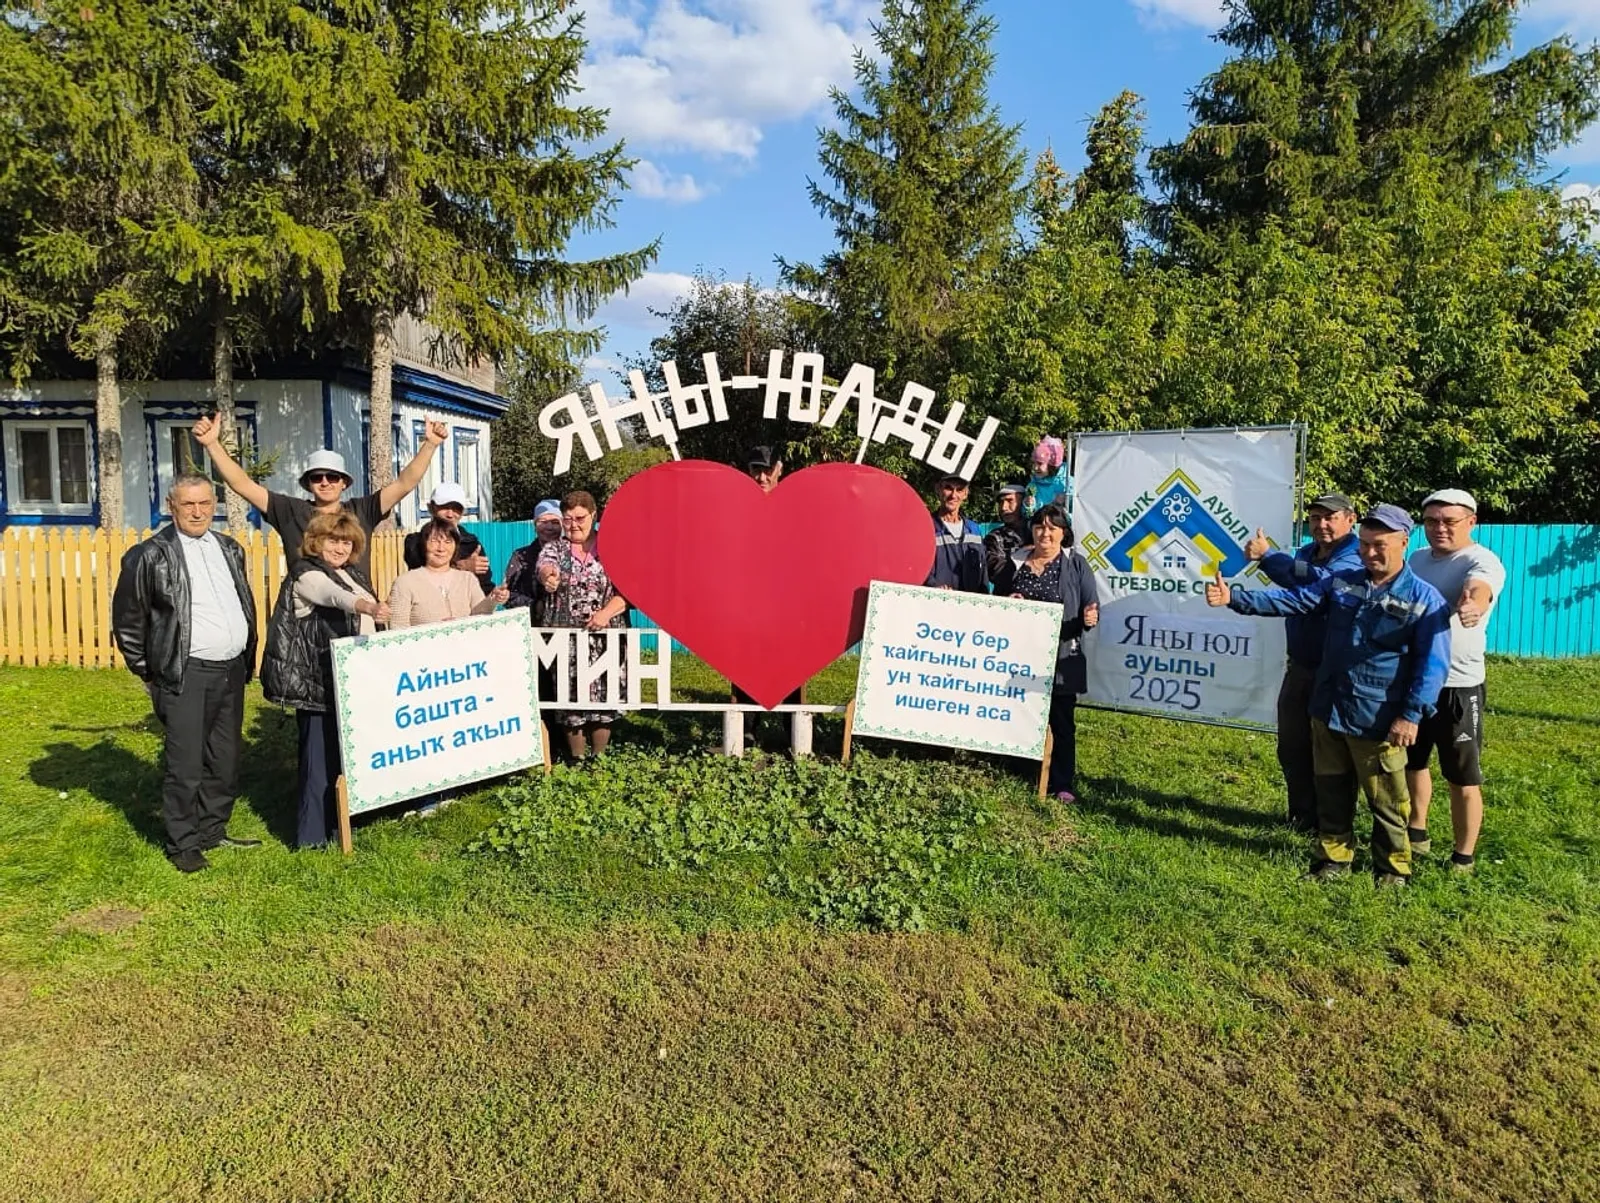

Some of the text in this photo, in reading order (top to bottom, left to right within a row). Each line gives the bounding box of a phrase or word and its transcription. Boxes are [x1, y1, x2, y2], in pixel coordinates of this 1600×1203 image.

[1109, 490, 1249, 541] АЙЫҠ АУЫЛ
[1107, 575, 1245, 596] ТРЕЗВОЕ СО
[916, 621, 1010, 652] Эсеү бер
[1117, 614, 1252, 657] Яңы юл
[531, 628, 671, 707] МИН
[882, 643, 977, 669] ҡайғыны
[1124, 653, 1215, 678] ауылы
[395, 660, 488, 697] Айныҡ
[886, 669, 911, 686] ун
[1129, 675, 1201, 711] 2025
[394, 695, 478, 730] башта
[895, 693, 1011, 722] ишеген аса
[370, 716, 521, 770] аныҡ аҡыл
